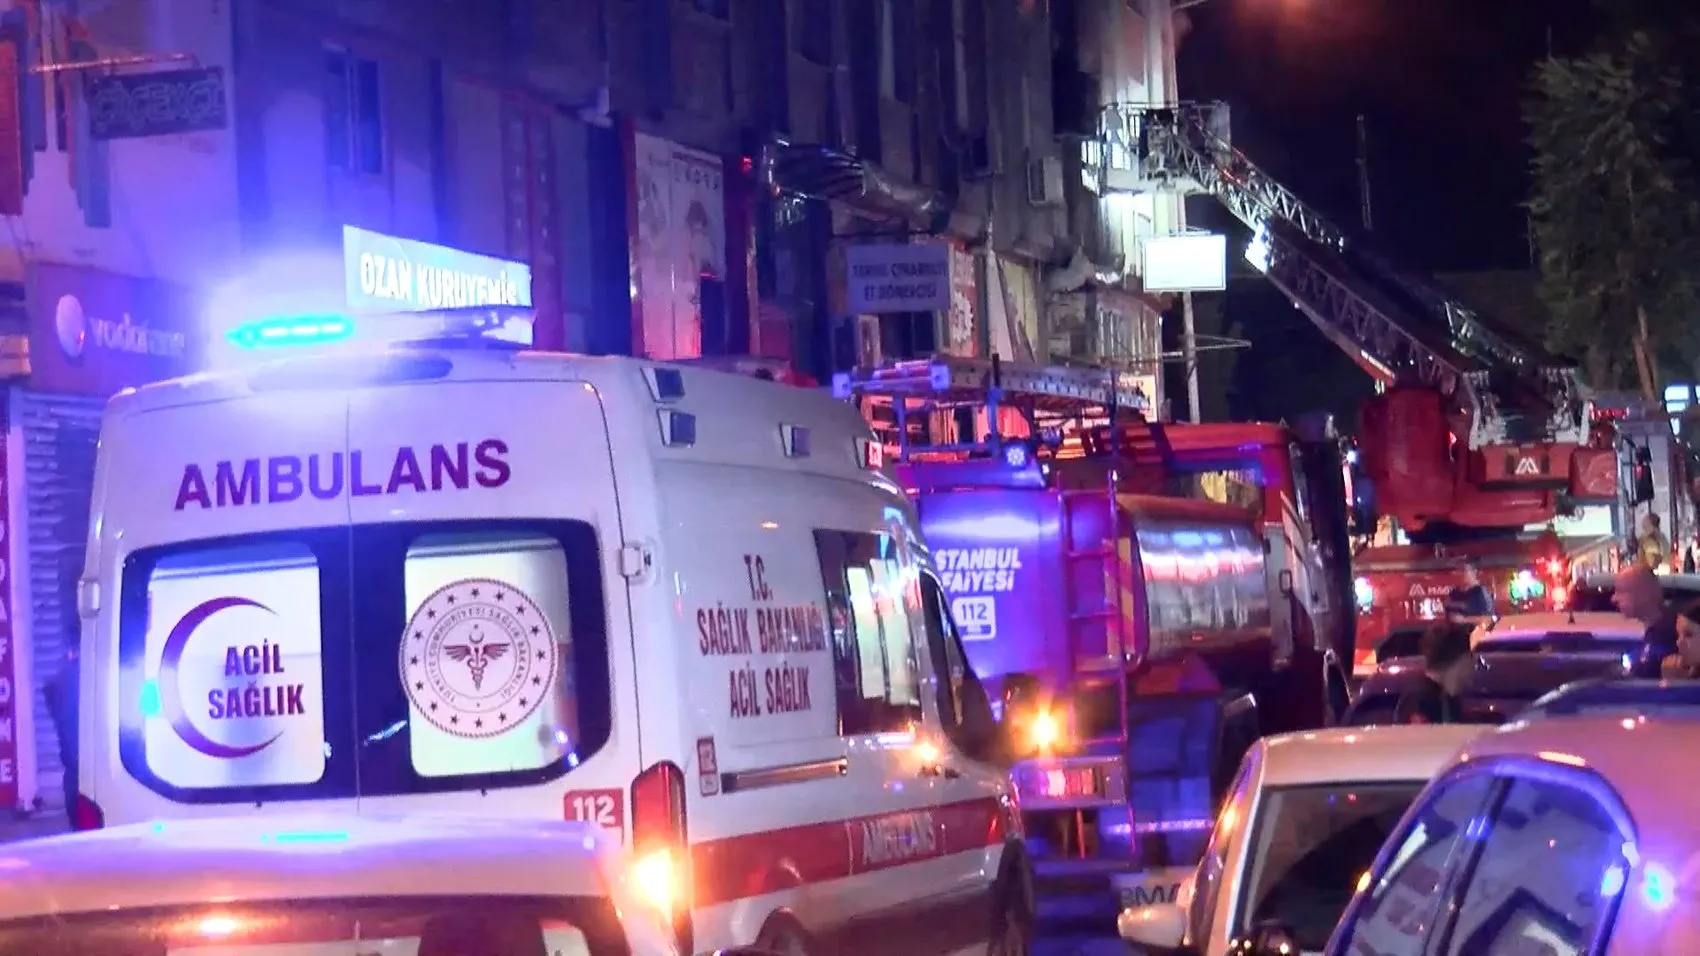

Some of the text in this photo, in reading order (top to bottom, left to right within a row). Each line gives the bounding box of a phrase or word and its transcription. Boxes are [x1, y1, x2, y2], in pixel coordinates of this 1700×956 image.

[361, 252, 412, 300] OZAN
[174, 439, 511, 511] AMBULANS
[935, 547, 1022, 572] STANBUL
[941, 569, 1015, 593] FAİYESİ
[697, 600, 753, 656] SAĞLIK
[961, 602, 987, 621] 112
[225, 638, 285, 677] ACİL
[208, 680, 306, 719] SAĞLIK
[729, 660, 812, 718] ACİL SAĞLIK
[573, 795, 617, 825] 112
